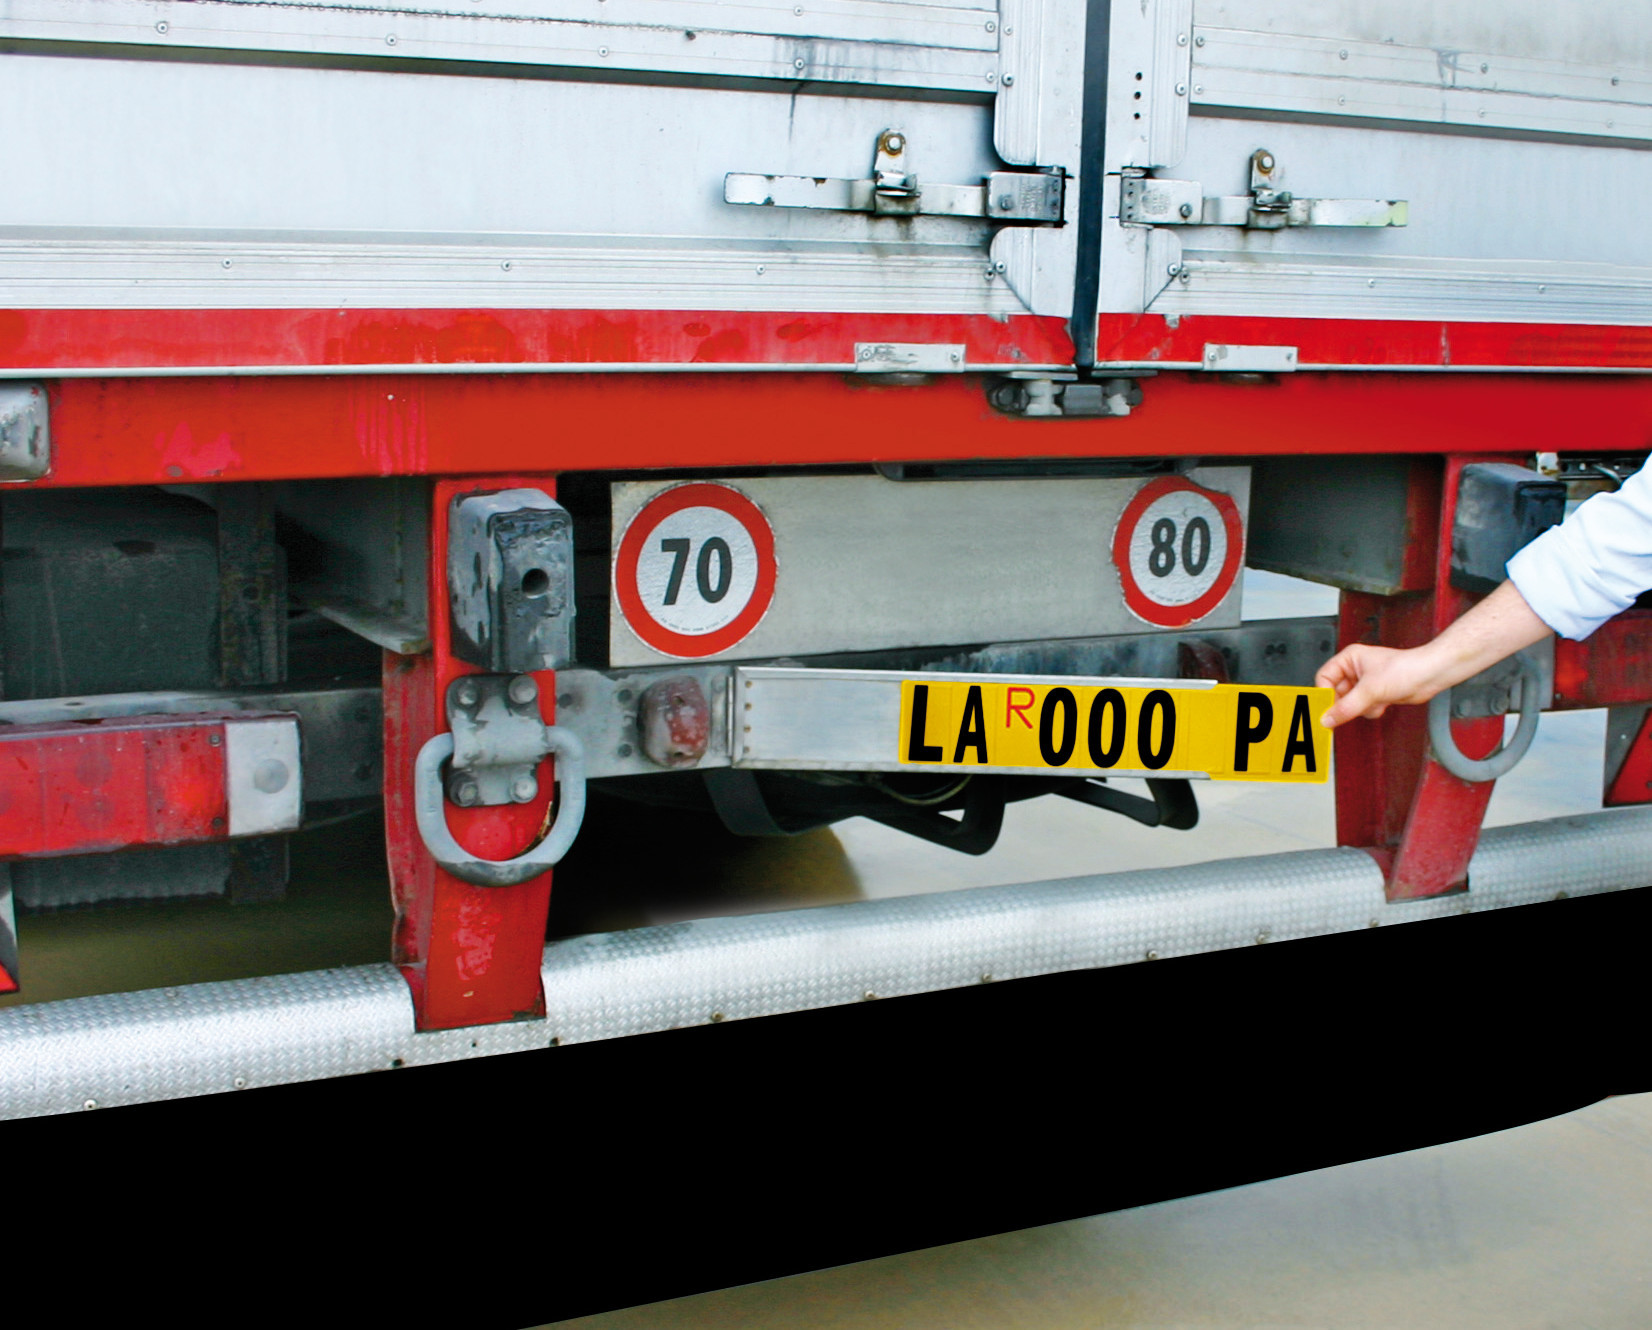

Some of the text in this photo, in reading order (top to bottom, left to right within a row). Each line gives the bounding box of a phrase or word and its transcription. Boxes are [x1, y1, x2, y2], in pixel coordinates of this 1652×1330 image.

[660, 536, 733, 606] 70
[1148, 515, 1212, 578] 80
[907, 684, 989, 764] LA
[1005, 686, 1036, 730] R
[1233, 691, 1317, 773] PA
